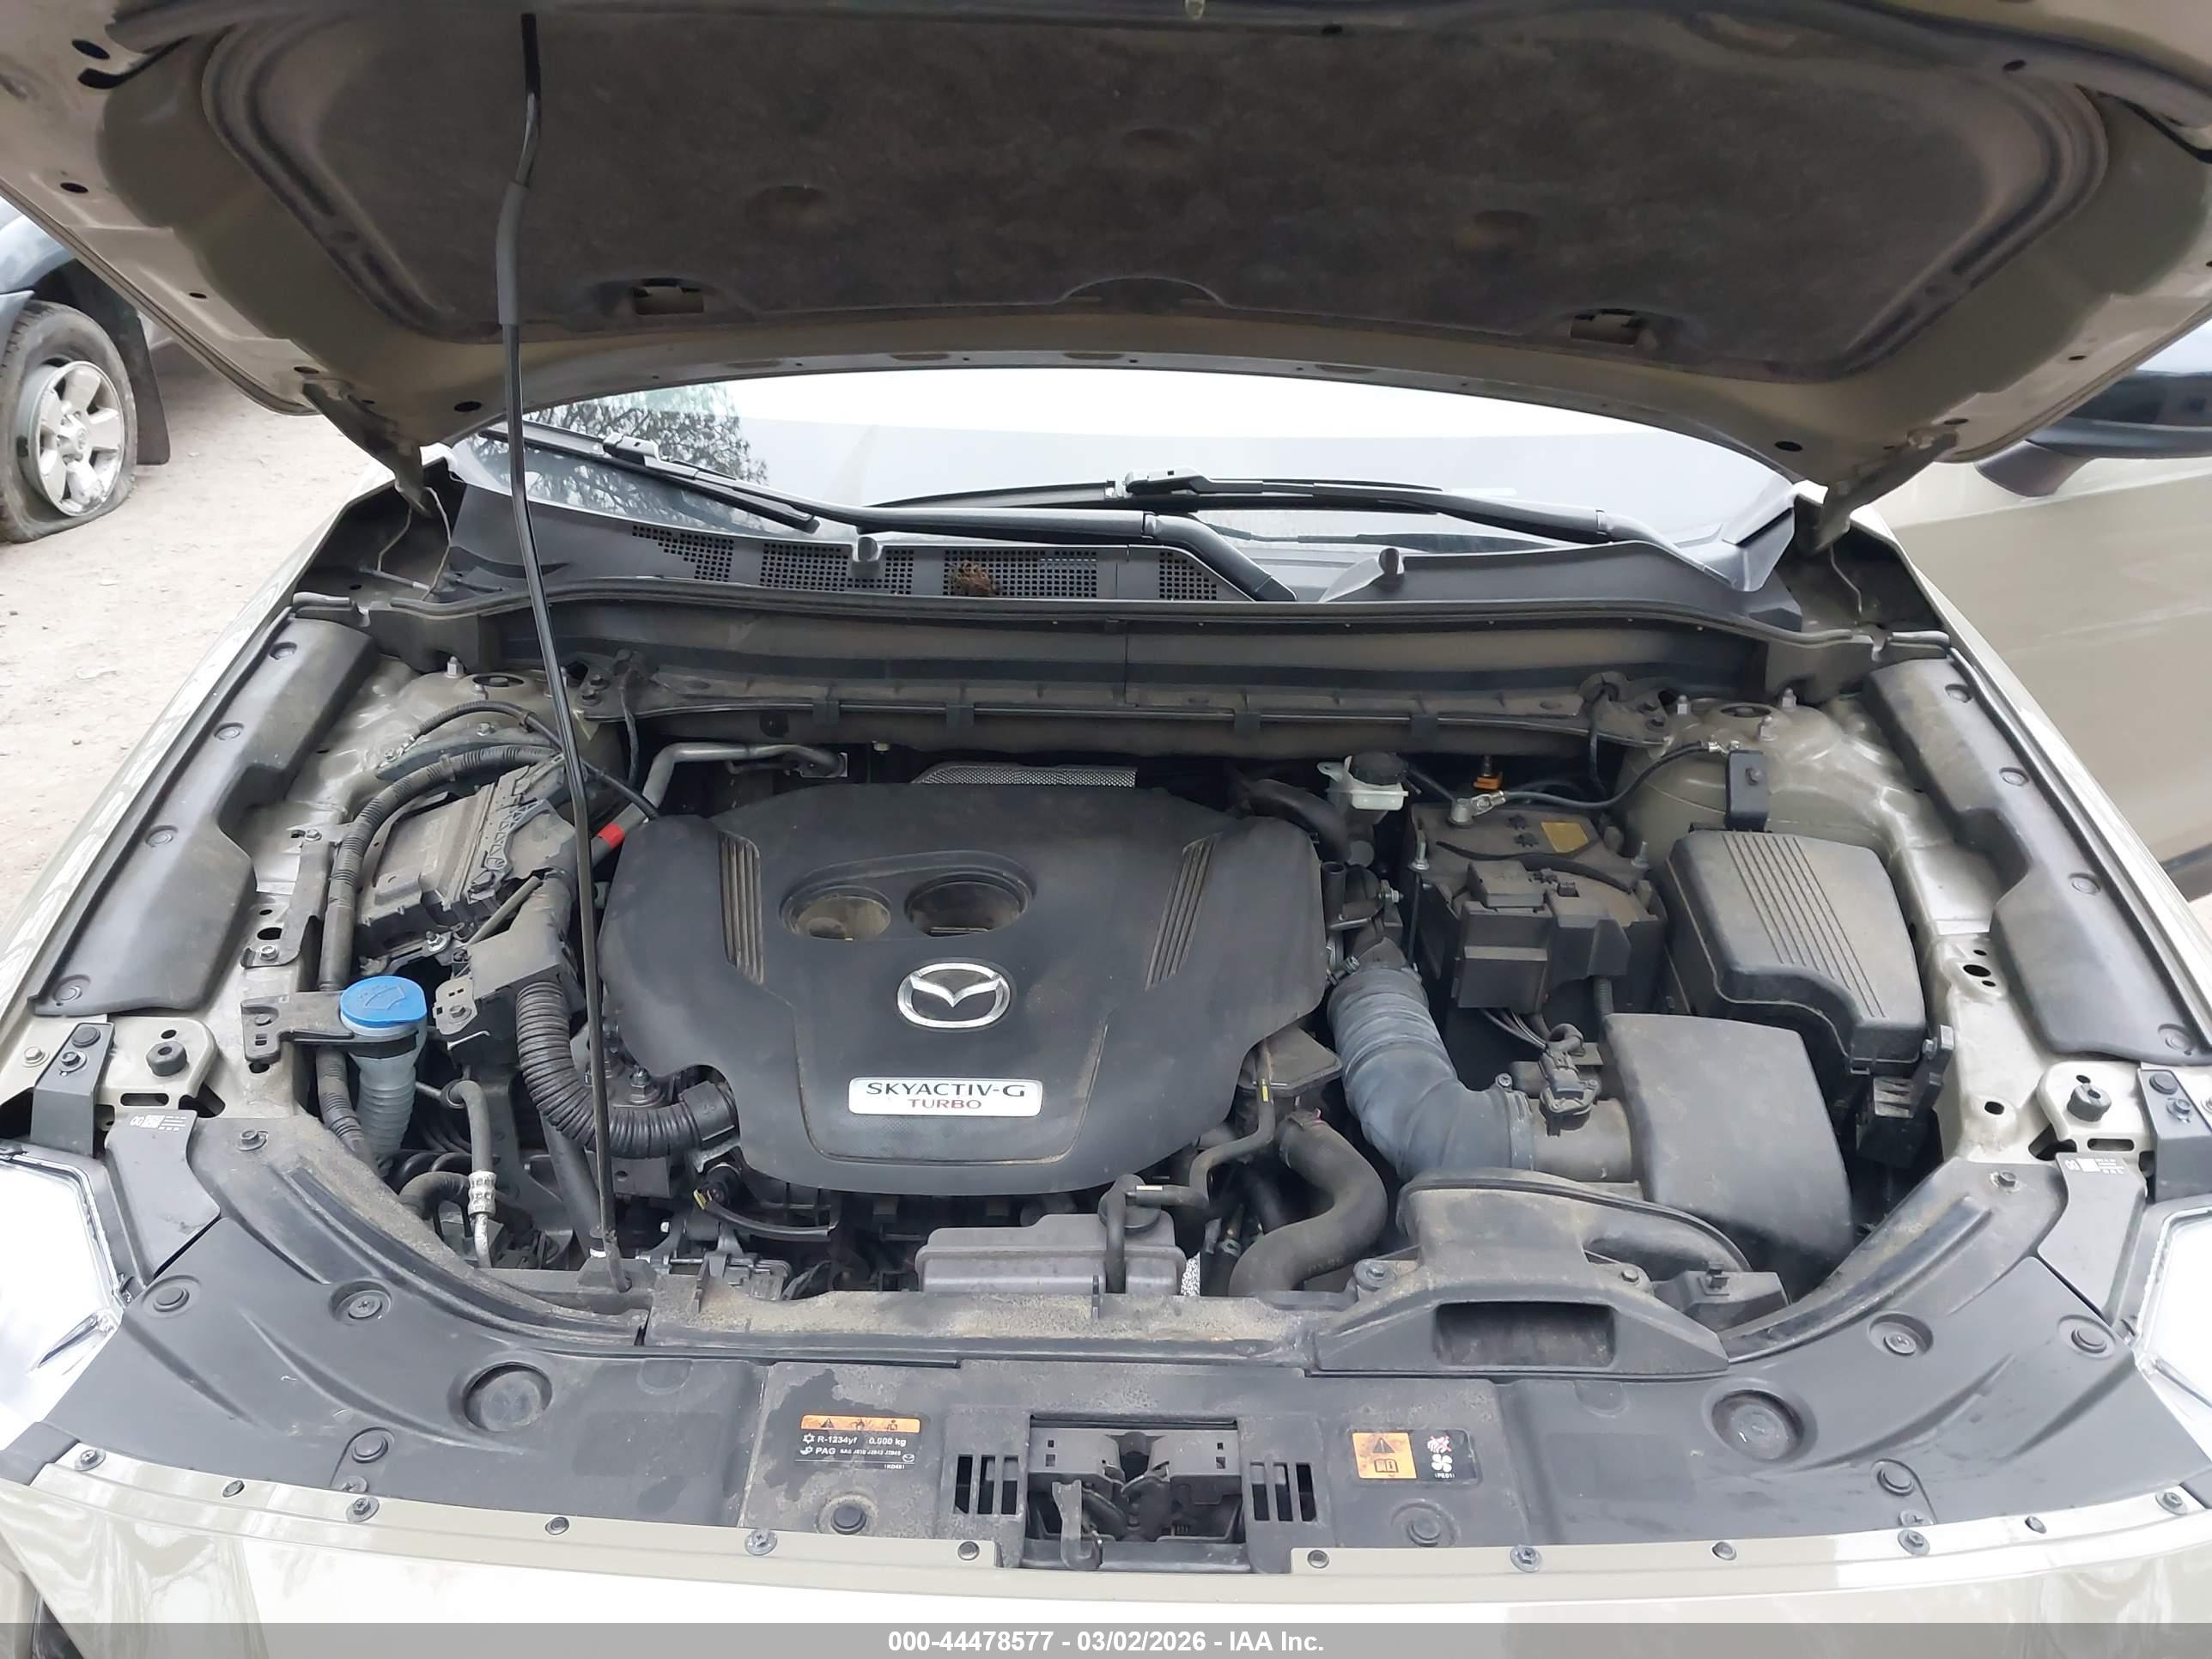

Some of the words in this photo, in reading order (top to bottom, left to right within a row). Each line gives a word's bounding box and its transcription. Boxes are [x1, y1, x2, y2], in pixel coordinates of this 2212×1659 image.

[866, 1083, 1024, 1097] SKYACTIV-G
[908, 1098, 982, 1109] TURBO
[817, 1436, 857, 1444] R-1234yf
[895, 1437, 907, 1447] kg
